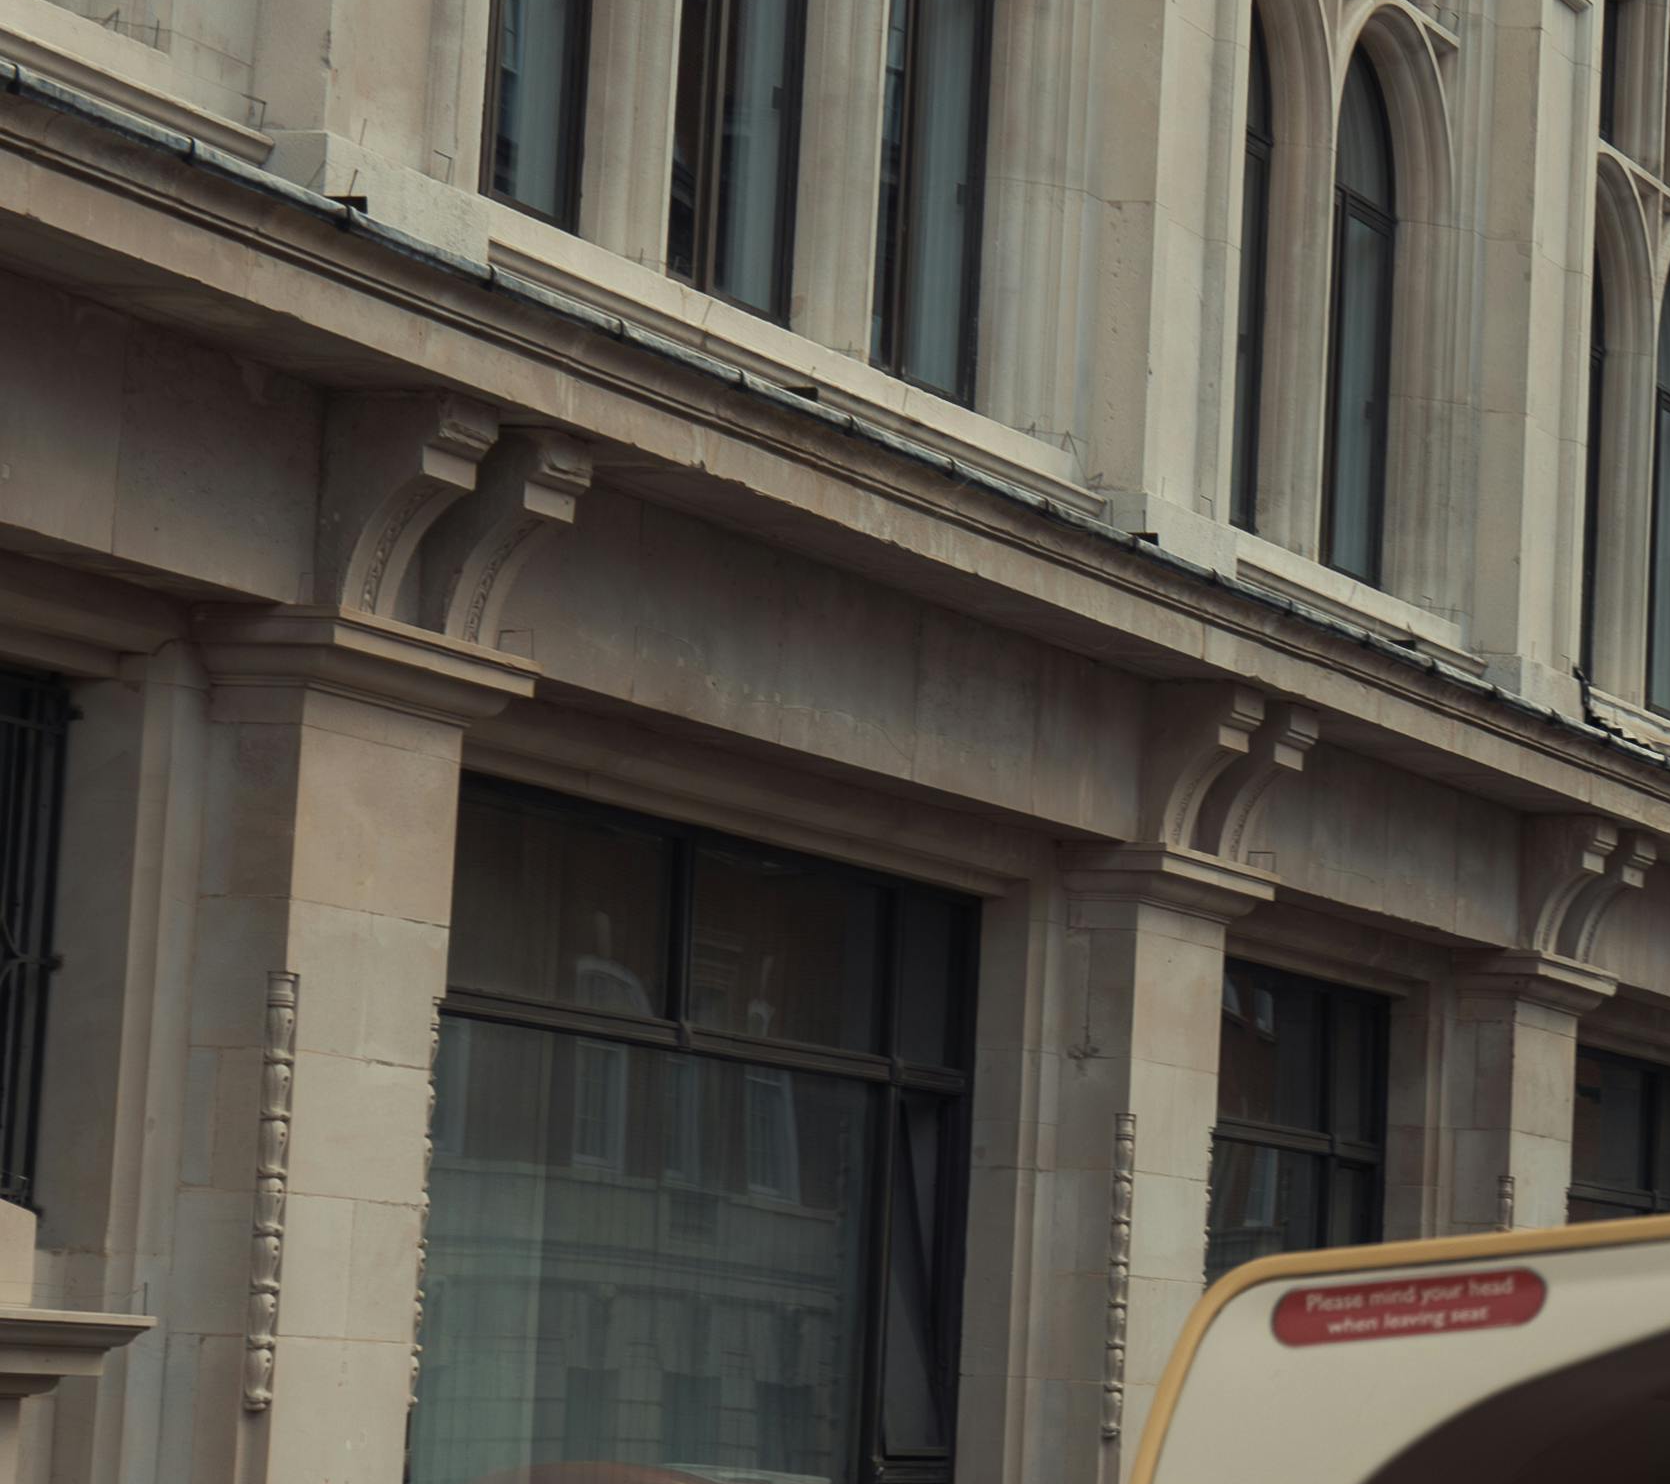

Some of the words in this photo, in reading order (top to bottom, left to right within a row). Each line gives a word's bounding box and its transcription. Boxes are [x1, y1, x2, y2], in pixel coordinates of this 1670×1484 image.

[1305, 1290, 1363, 1313] Please
[1369, 1285, 1417, 1306] mind
[1420, 1282, 1463, 1306] your
[1468, 1276, 1515, 1298] head
[1327, 1315, 1378, 1334] when
[1383, 1308, 1446, 1329] leaving
[1450, 1306, 1491, 1324] seat
